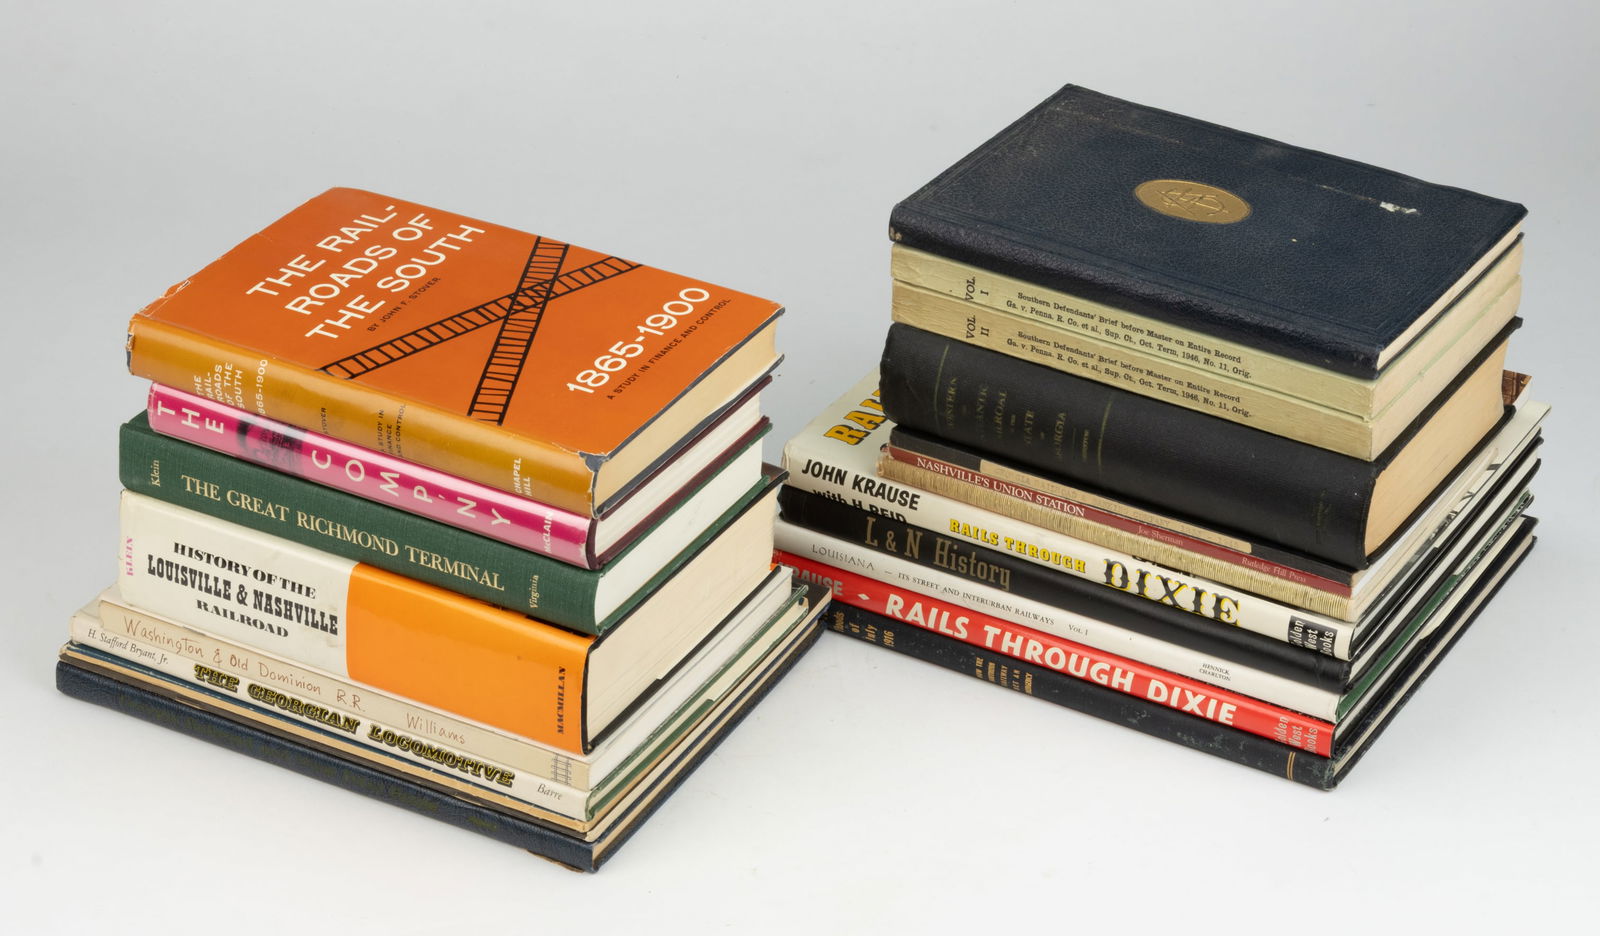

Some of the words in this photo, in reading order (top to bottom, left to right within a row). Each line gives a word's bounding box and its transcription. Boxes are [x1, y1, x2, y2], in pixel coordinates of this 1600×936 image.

[246, 254, 326, 296] THE
[316, 205, 396, 253] RAIL-
[284, 244, 398, 315] ROADS
[393, 213, 435, 241] OF
[304, 294, 386, 338] THE
[376, 224, 485, 292] SOUTH
[367, 322, 378, 332] BY
[380, 306, 402, 323] JOHN
[408, 276, 442, 301] STOVER
[965, 276, 976, 301] VOL.
[566, 287, 710, 394] 1865-1900
[613, 371, 640, 394] STUDY
[640, 364, 650, 374] IN
[648, 337, 682, 364] FINANCE
[680, 325, 698, 340] AND
[696, 297, 731, 326] CONTROL
[966, 315, 976, 340] VOL.
[980, 327, 990, 337] II
[1006, 300, 1018, 310] Ga.
[1030, 308, 1054, 320] Penna.
[1056, 314, 1065, 323] R.
[1067, 318, 1079, 327] Co.
[1104, 328, 1121, 340] Sup.
[1139, 338, 1154, 349] Oct.
[1157, 343, 1178, 358] Term,
[1203, 357, 1216, 368] No.
[1232, 366, 1252, 380] Orig.
[1018, 292, 1051, 308] Southern
[1053, 302, 1096, 320] Defendants'
[1099, 316, 1118, 326] Brief
[1120, 321, 1144, 335] before
[1146, 329, 1173, 343] Master
[1175, 338, 1185, 346] on
[1188, 340, 1212, 355] Entire
[1214, 349, 1242, 364] Record
[224, 362, 232, 388] THE
[1006, 338, 1018, 348] Ga.
[1030, 346, 1054, 358] Penna.
[1068, 357, 1079, 366] Co.
[1104, 368, 1121, 380] Sup.
[1138, 378, 1154, 388] Oct.
[1202, 396, 1216, 407] No.
[1018, 331, 1051, 346] Southern
[1053, 341, 1096, 359] Defendants'
[1098, 355, 1118, 366] Brief
[1120, 360, 1144, 374] before
[1146, 368, 1172, 382] Master
[1174, 378, 1184, 386] on
[1186, 380, 1210, 395] Entire
[1213, 390, 1240, 404] Record
[152, 460, 161, 488] Klein
[513, 458, 522, 494] CHAPEL
[523, 476, 532, 497] HILL
[802, 459, 848, 486] JOHN
[852, 474, 921, 511] KRAUSE
[916, 457, 990, 488] NASHVILLE'S
[994, 480, 1033, 502] UNION
[1035, 494, 1086, 517] STATION
[1136, 525, 1149, 536] Joe
[180, 474, 221, 502] THE
[226, 488, 290, 522] GREAT
[296, 510, 399, 557] RICHMOND
[404, 545, 505, 592] TERMINAL
[865, 517, 878, 547] L
[885, 530, 896, 552] &
[904, 529, 923, 560] N
[932, 538, 1011, 592] History
[148, 554, 232, 601] LOUISVILLE
[236, 584, 248, 606] &
[253, 588, 338, 636] NASHVILLE
[174, 542, 252, 578] HISTORY
[252, 568, 278, 586] OF
[278, 577, 316, 600] THE
[529, 574, 540, 610] Virginia
[812, 544, 876, 572] LOUISIANA
[898, 572, 911, 582] ITS
[912, 576, 939, 590] STREET
[942, 585, 960, 597] AND
[962, 592, 1012, 614] INTERURBAN
[1014, 608, 1056, 626] RAILWAYS
[950, 518, 1000, 546] RAILS
[1004, 537, 1086, 574] THROUGH
[1102, 558, 1240, 626] DIXIE
[88, 628, 98, 640] H.
[99, 630, 129, 652] Stafford
[130, 643, 158, 662] Bryant,
[158, 654, 169, 665] Jr.
[196, 600, 289, 638] RAILROAD
[124, 616, 204, 658] Washington
[229, 654, 249, 672] Old
[258, 661, 322, 696] Dominion
[406, 712, 466, 746] Williams
[885, 592, 970, 640] RAILS
[983, 624, 1135, 692] THROUGH
[1146, 678, 1238, 726] DIXIE
[194, 663, 240, 694] THE
[247, 684, 361, 734] GEORGIAN
[367, 723, 516, 788] LOCOMOTIVE
[556, 666, 566, 735] MACMILLAN
[536, 782, 564, 801] Barre
